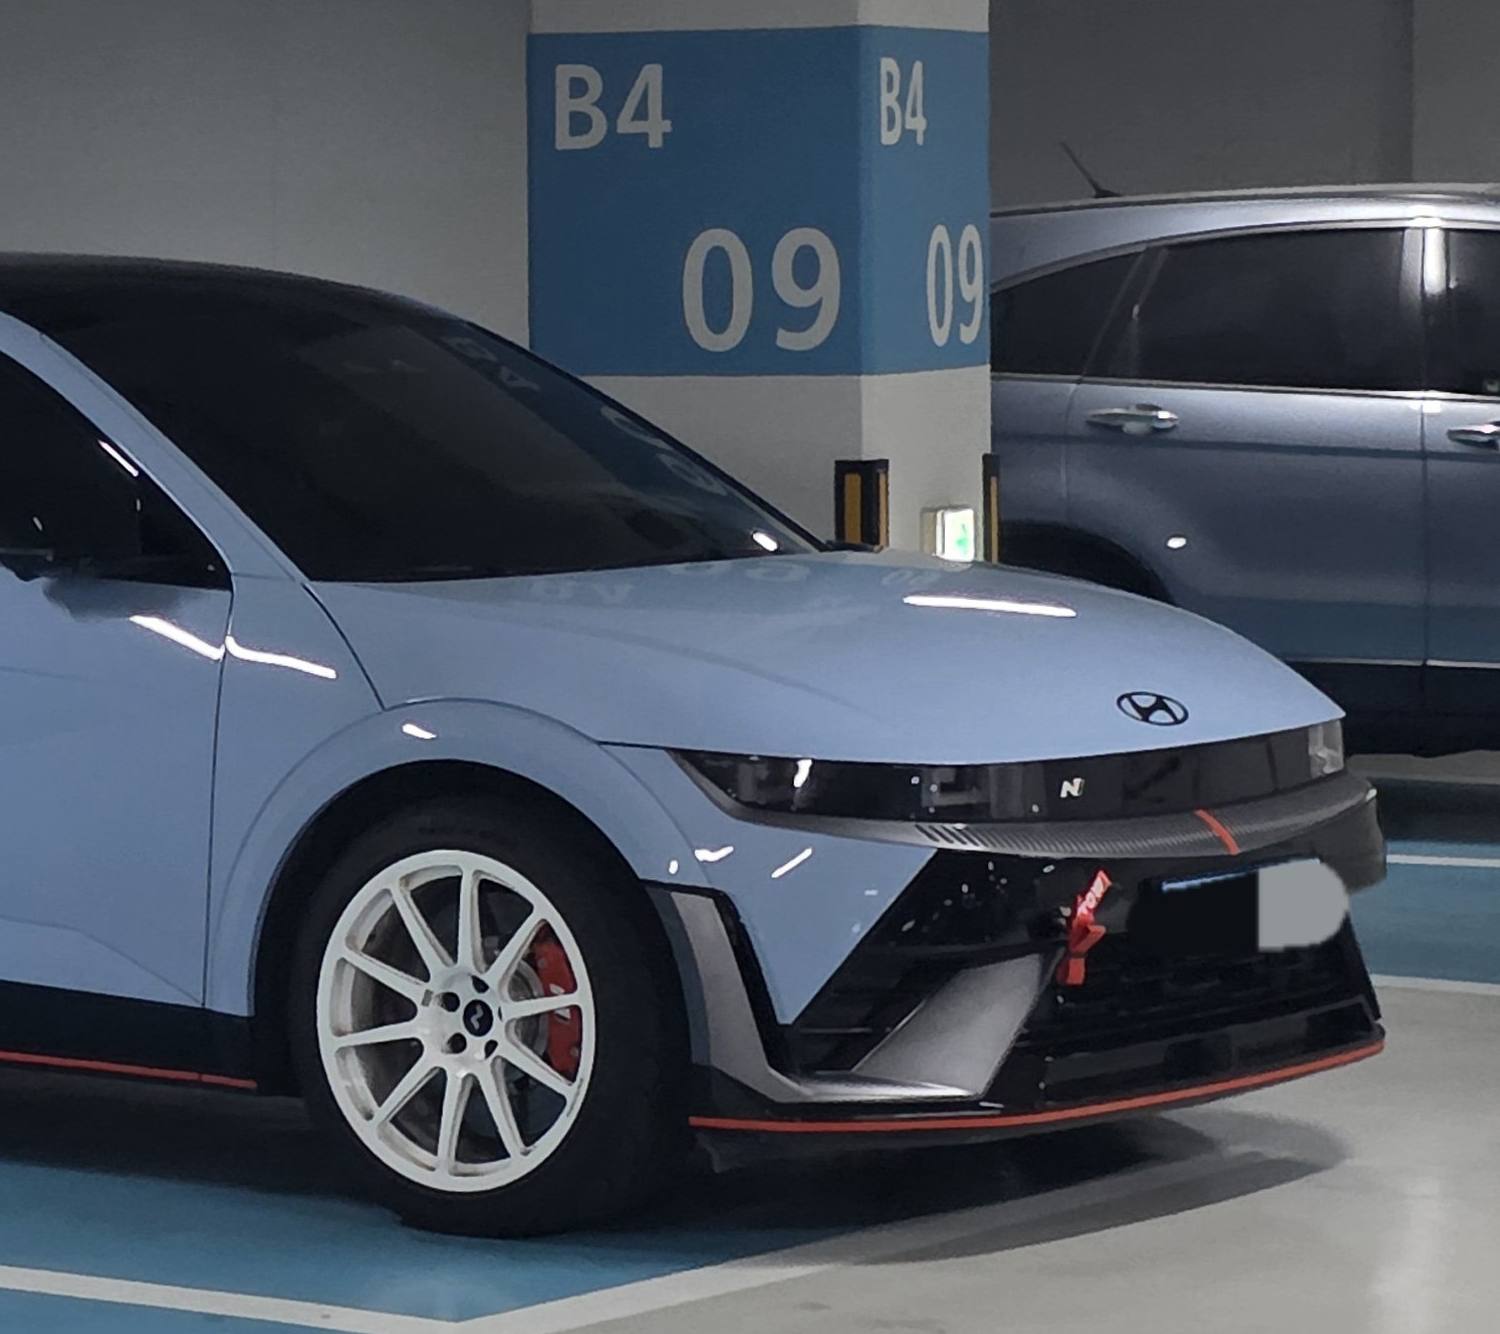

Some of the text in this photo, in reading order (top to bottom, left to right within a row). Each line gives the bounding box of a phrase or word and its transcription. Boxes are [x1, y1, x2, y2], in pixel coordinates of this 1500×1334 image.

[555, 64, 672, 150] B4
[879, 57, 927, 145] B4
[683, 227, 841, 352] 09
[927, 224, 984, 347] 09
